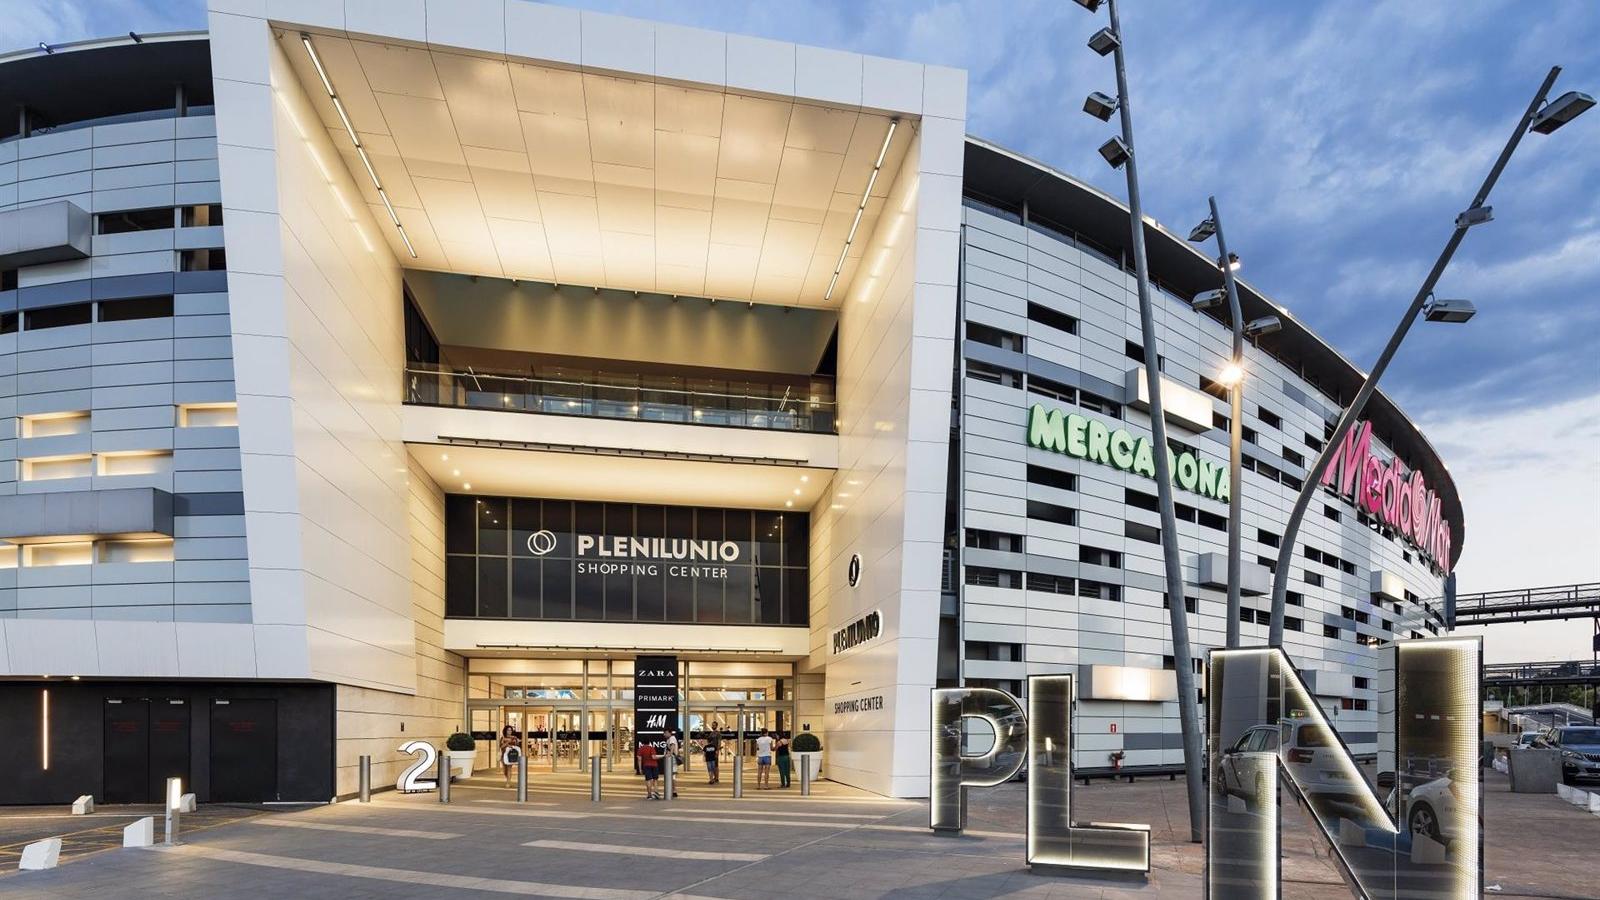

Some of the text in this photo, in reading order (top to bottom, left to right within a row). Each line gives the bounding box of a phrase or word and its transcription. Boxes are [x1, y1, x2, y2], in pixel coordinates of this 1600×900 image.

[1321, 420, 1412, 537] Media
[577, 535, 740, 562] PLENILUNIO
[577, 562, 728, 579] SHOPPING CENTER
[833, 610, 882, 655] PLENILUNIO
[834, 695, 883, 714] SHOPPING CENTER
[646, 714, 667, 729] H&M
[396, 740, 437, 794] 2
